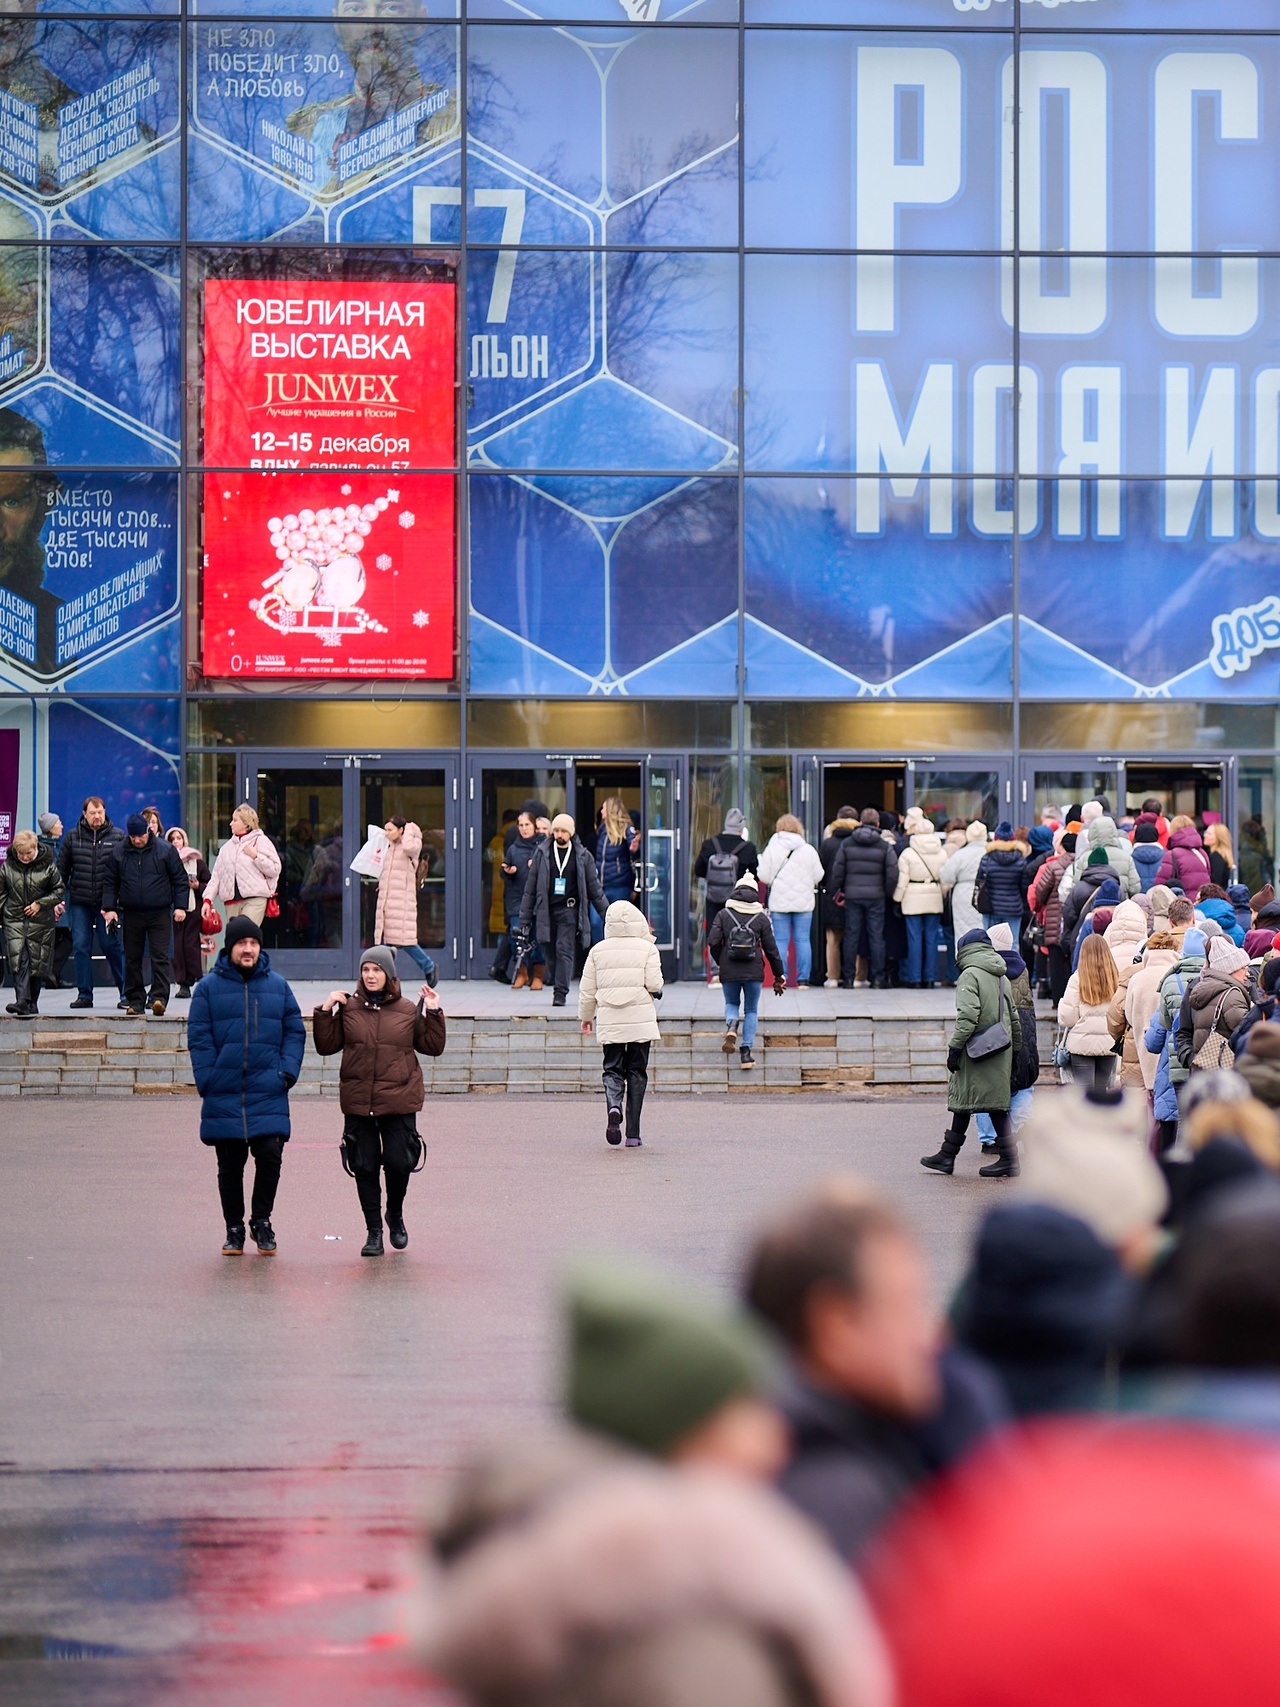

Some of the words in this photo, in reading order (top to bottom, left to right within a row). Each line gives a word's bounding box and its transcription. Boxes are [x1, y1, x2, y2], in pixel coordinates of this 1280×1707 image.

[208, 28, 232, 48] НЕ
[239, 28, 275, 48] ЗЛО
[208, 53, 299, 78] ПОБЕДИТ
[303, 53, 344, 78] ЗЛО,
[60, 58, 150, 125] ГОСУДАРСТВЕННЫЙ
[106, 77, 160, 119] СОЗДАТЕЛЬ
[207, 77, 219, 97] А
[60, 107, 137, 162] ЧЕРНОМОРСКОГО
[262, 119, 305, 158] НИКОЛАЙ
[340, 117, 394, 163] ПОСЛЕДНИЙ
[397, 89, 449, 130] ИМПЕРАТОР
[60, 146, 105, 183] ВОЕННОГО
[107, 125, 139, 156] ФЛОТА
[271, 144, 313, 181] 1868-1918
[340, 122, 416, 182] ВСЕРОССИЙСКИЙ
[236, 298, 425, 327] ЮВЕЛИРНАЯ
[251, 332, 411, 361] ВЫСТАВКА
[470, 335, 548, 378] ЛЬОН
[263, 373, 400, 407] JUNWEX
[266, 407, 302, 418] Лучшие
[304, 410, 354, 418] украшения
[364, 408, 397, 418] России
[319, 433, 410, 457] декабря
[856, 363, 1121, 536] МОЯ
[45, 510, 112, 528] ТЫСЯЧИ
[81, 530, 149, 549] ТЫСЯЧИ
[58, 596, 84, 624] ОДИН
[86, 588, 98, 606] ИЗ
[100, 553, 163, 600] ВЕЛИЧАЙШИХ
[58, 626, 65, 643] В
[66, 612, 92, 639] МИРЕ
[58, 615, 119, 663] РОМАНИСТОВ
[230, 654, 252, 672] 0+
